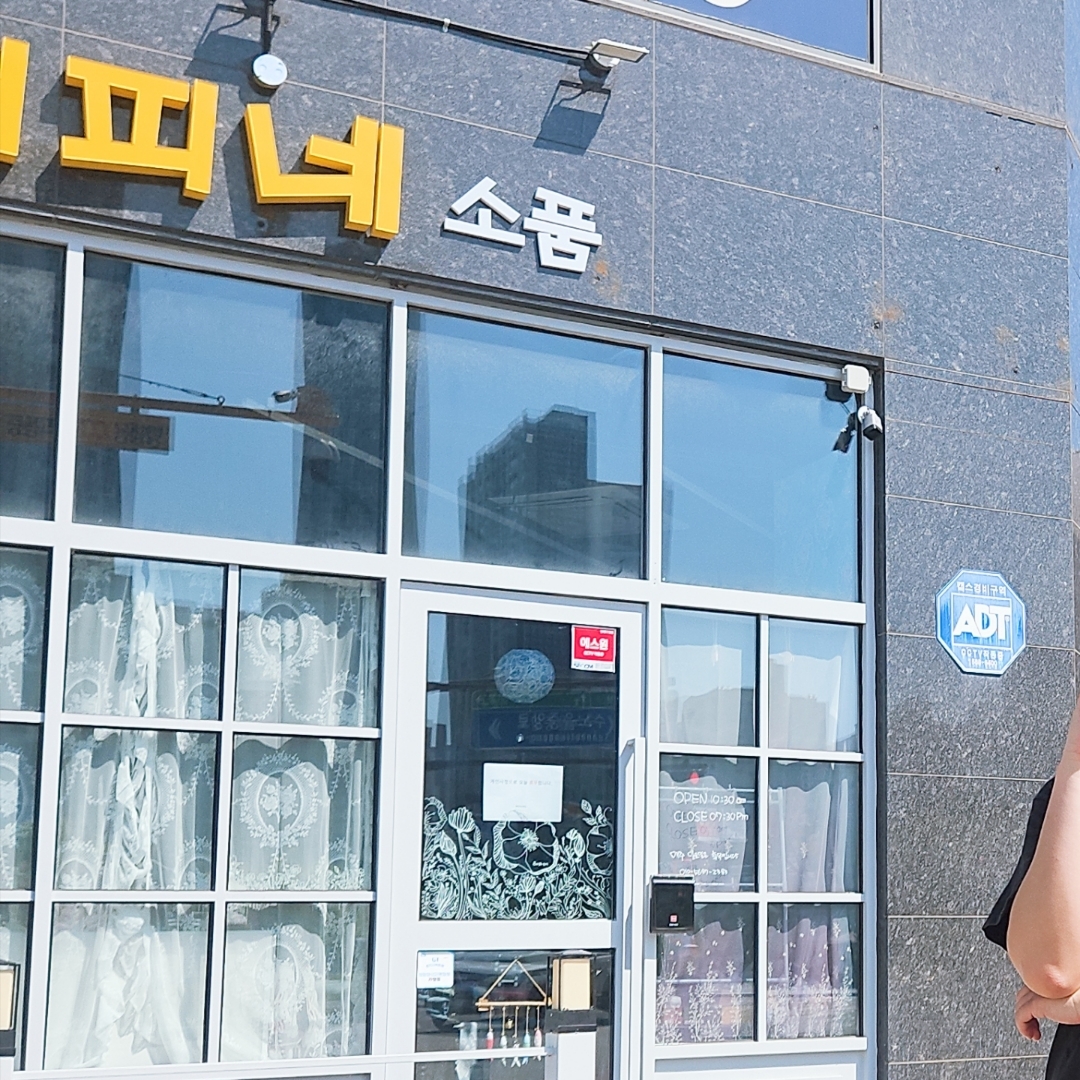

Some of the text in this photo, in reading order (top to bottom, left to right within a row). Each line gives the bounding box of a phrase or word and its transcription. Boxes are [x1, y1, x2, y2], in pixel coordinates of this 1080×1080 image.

[0, 37, 404, 240] 피네
[444, 176, 602, 273] 소품
[953, 602, 1011, 640] ADT
[579, 636, 609, 651] 에스원
[673, 791, 708, 805] OPEN
[710, 795, 735, 805] 10:30
[673, 810, 708, 824] CLOSE
